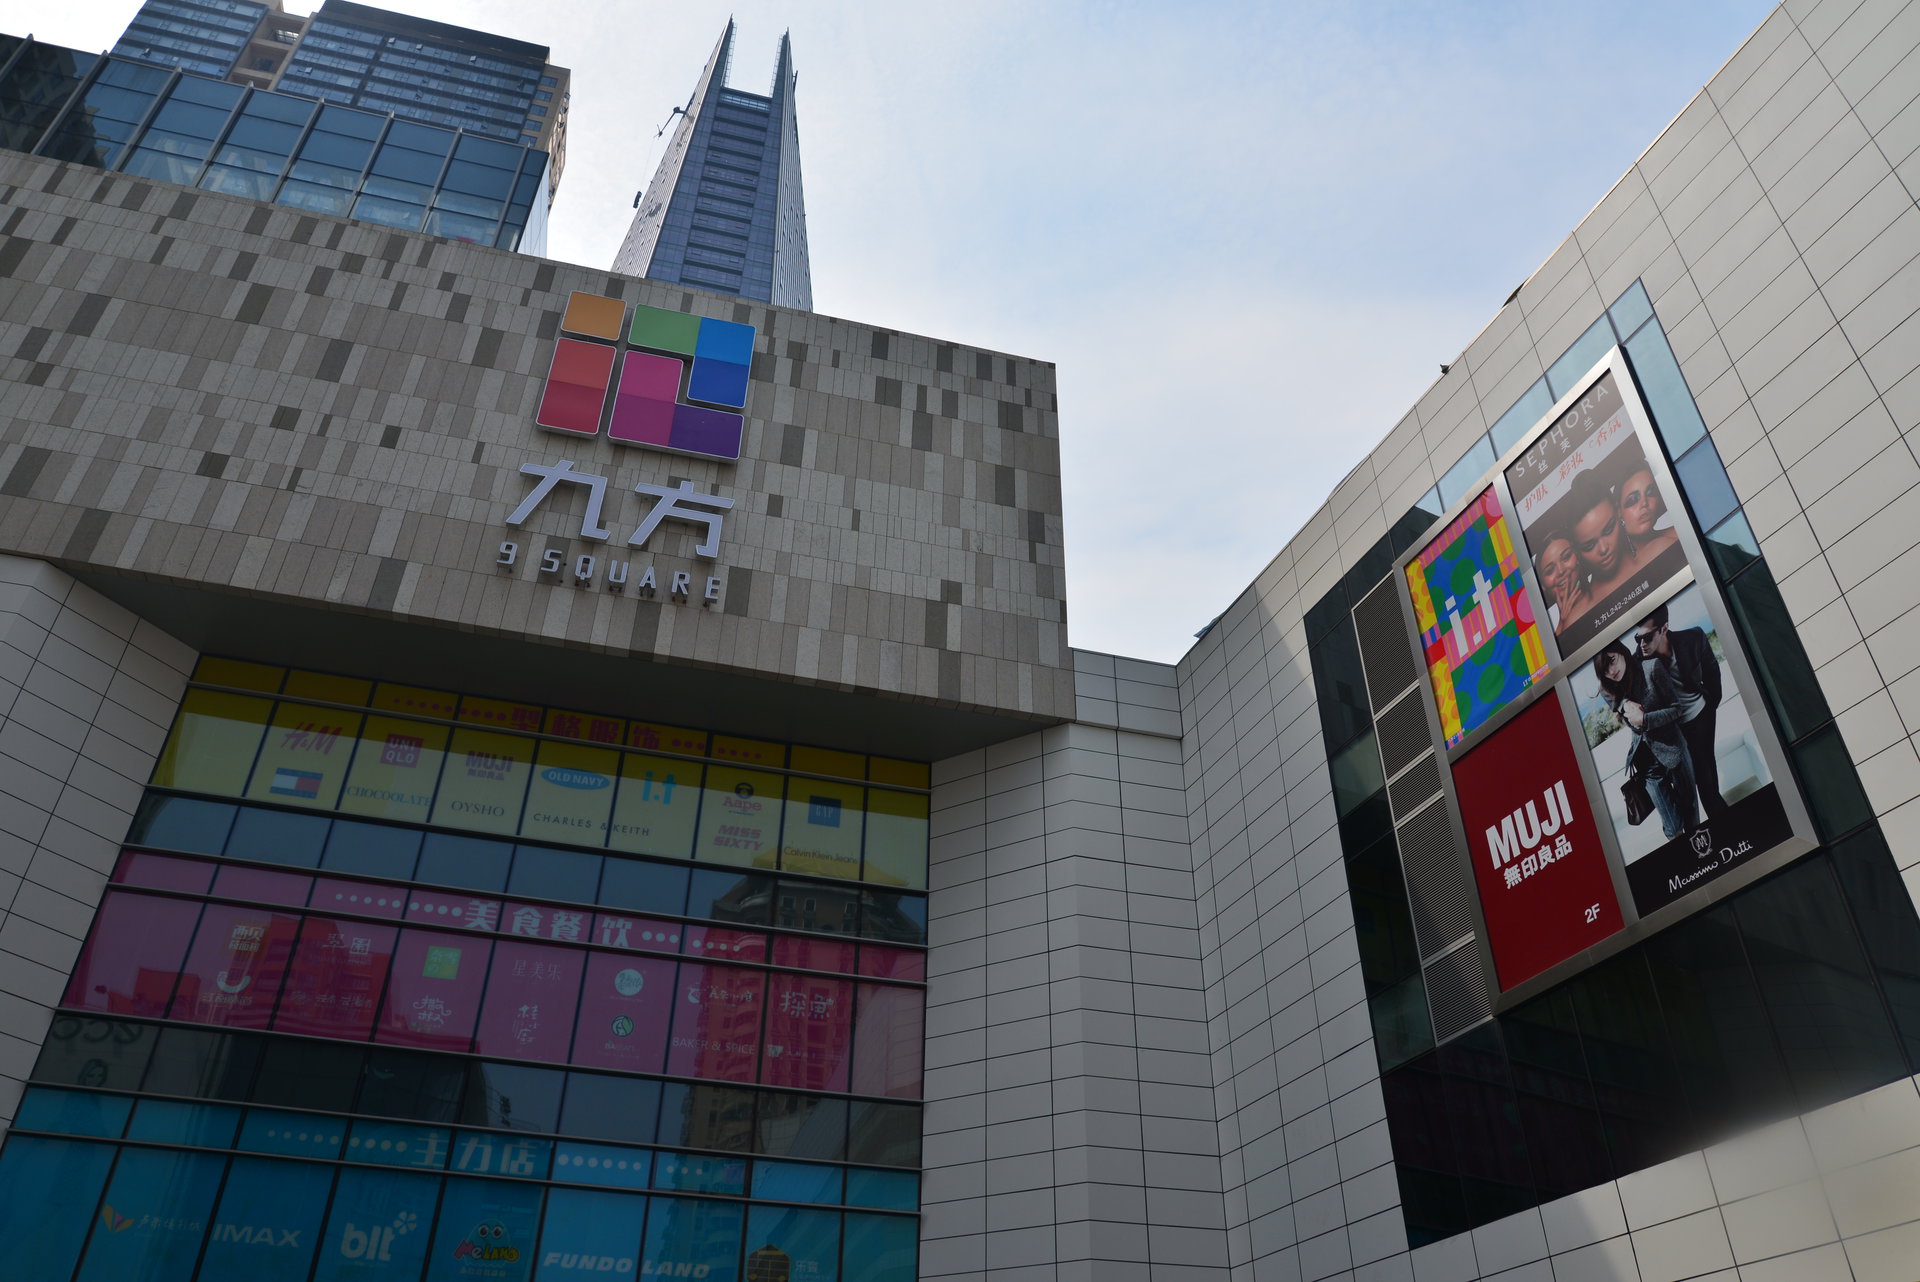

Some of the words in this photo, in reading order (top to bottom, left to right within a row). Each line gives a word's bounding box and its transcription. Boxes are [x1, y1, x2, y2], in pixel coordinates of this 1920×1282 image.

[1515, 384, 1609, 478] SEPHORA
[1538, 417, 1595, 474] 丝芙兰
[504, 459, 736, 560] 九方
[496, 541, 519, 566] 9
[540, 549, 722, 601] SQUARE
[1445, 569, 1498, 659] i.t
[280, 721, 343, 757] H&M
[389, 737, 418, 751] UNI
[385, 750, 415, 764] QLO
[464, 749, 514, 773] MUJI
[548, 770, 571, 783] OLD
[573, 774, 605, 788] NAVY
[641, 770, 677, 806] i.t
[451, 800, 505, 818] OYSHO
[721, 796, 763, 812] Aape
[815, 803, 833, 819] GAP
[532, 811, 593, 830] CHARLES
[612, 823, 651, 838] KEITH
[718, 824, 763, 840] MISS
[1485, 780, 1574, 871] MUJI
[711, 835, 765, 851] SIXTY
[783, 846, 811, 858] Calvin
[811, 848, 833, 861] Klein
[835, 852, 860, 864] Jeans
[1503, 834, 1574, 890] 無印良品
[1668, 860, 1719, 894] Massimo
[1719, 840, 1754, 865] Dutti
[464, 898, 633, 948] 美食餐饮
[1584, 903, 1601, 924] 2F
[672, 1036, 709, 1051] BAKER
[711, 1040, 721, 1052] &
[724, 1041, 756, 1056] SPICE
[410, 1131, 537, 1177] 主力店
[211, 1222, 303, 1249] IMAX
[340, 1221, 395, 1263] blt
[542, 1251, 633, 1274] FUNDO
[641, 1257, 712, 1280] LAND
